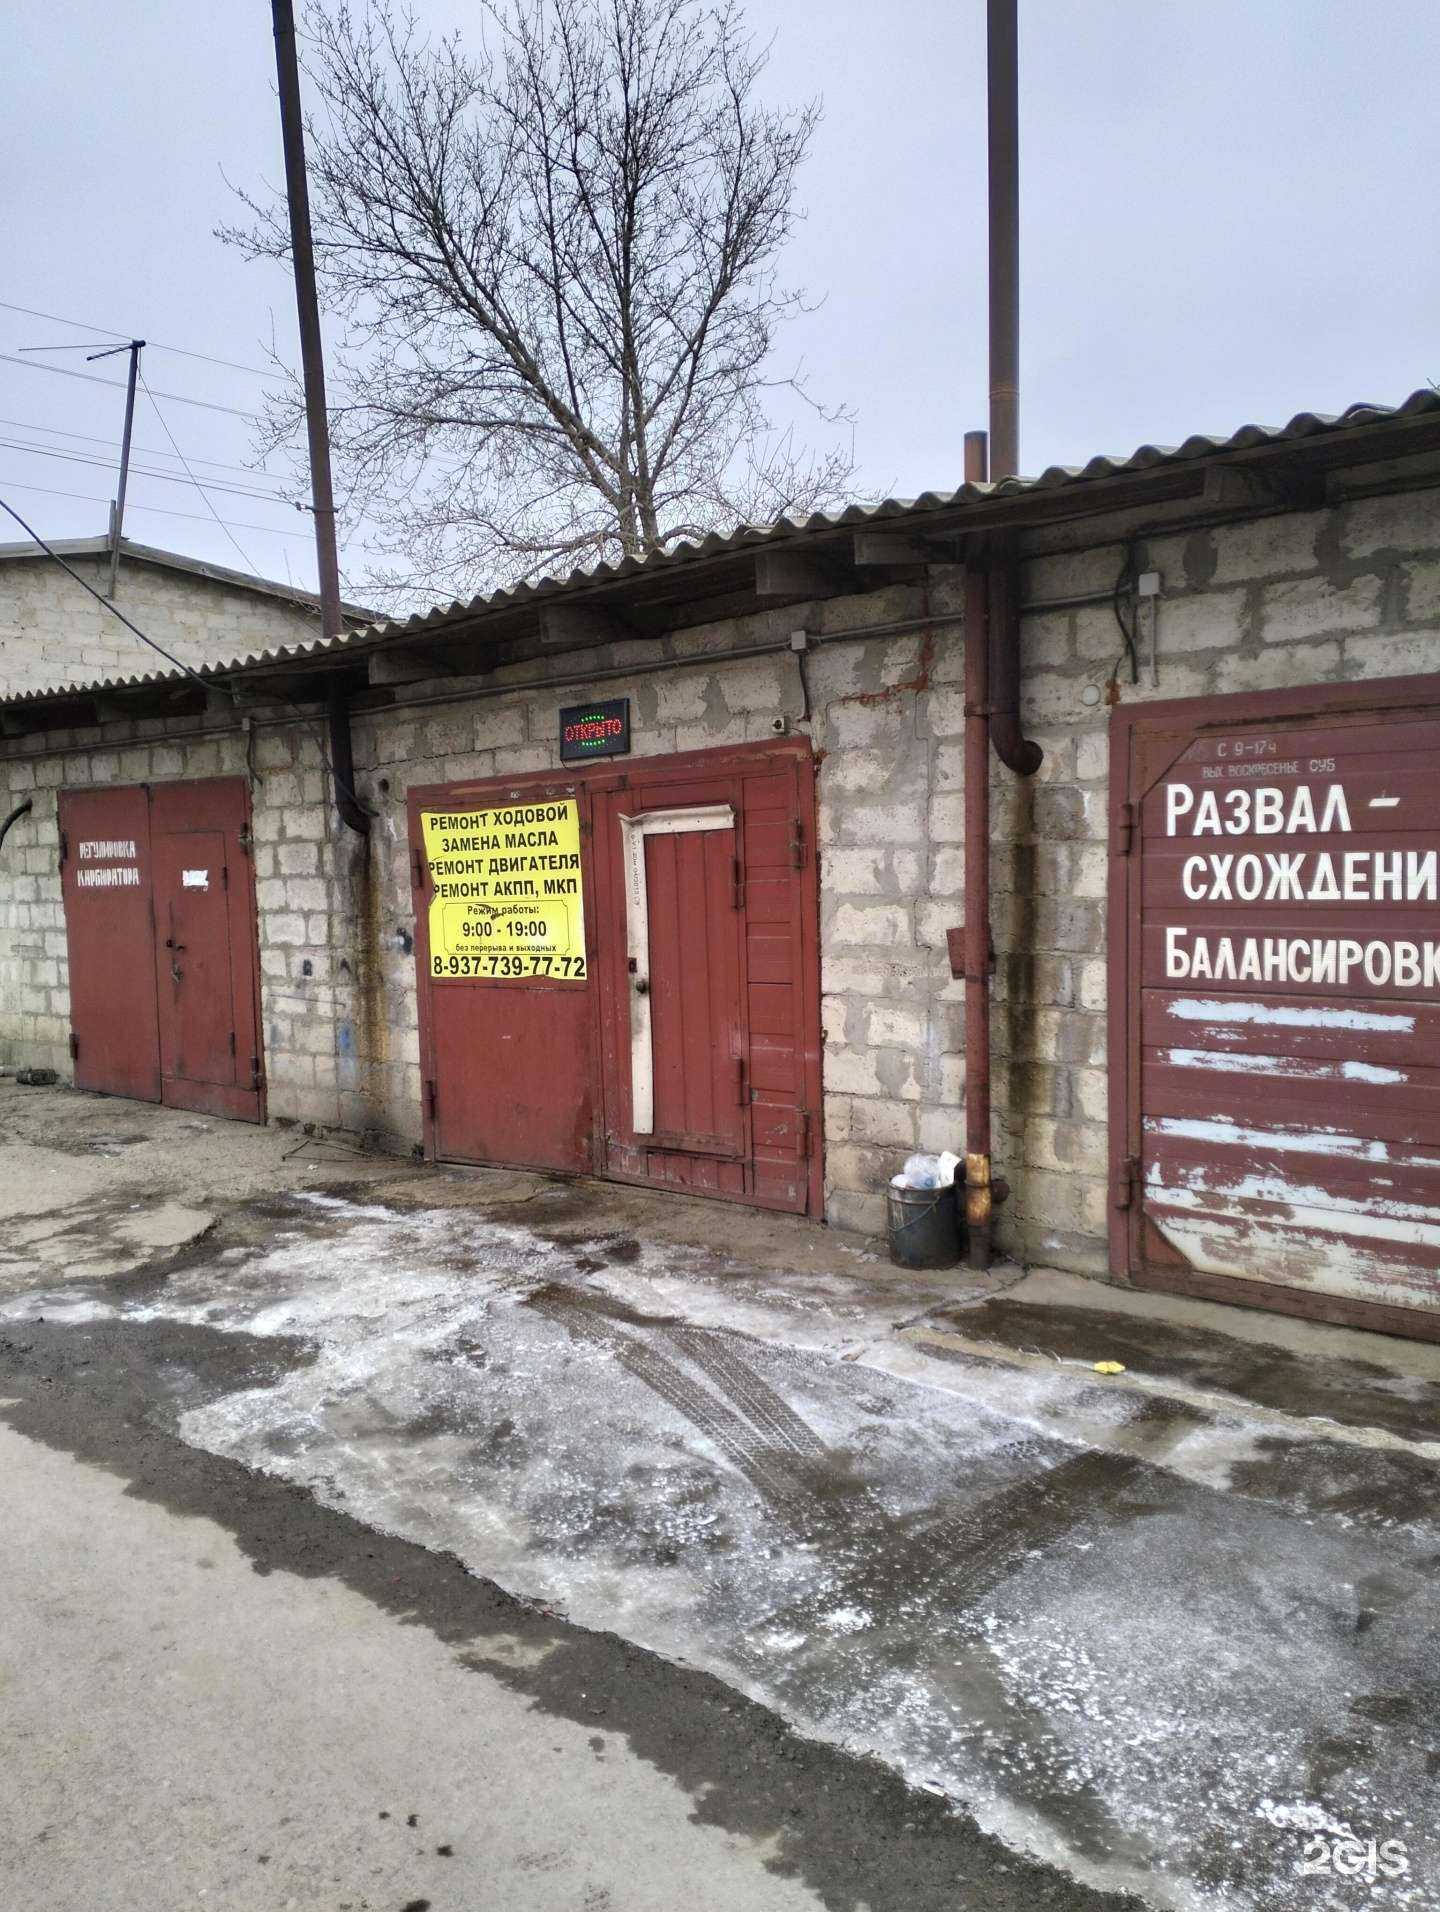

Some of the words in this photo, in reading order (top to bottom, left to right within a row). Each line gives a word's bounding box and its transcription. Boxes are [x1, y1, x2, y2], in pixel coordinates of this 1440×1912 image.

[565, 719, 622, 742] ОТКРЫТО
[430, 813, 488, 831] РЕМОНТ
[493, 802, 568, 827] ХОДОВОЙ
[1166, 783, 1352, 837] РАЗВАЛ
[442, 835, 500, 852] ЗАМЕНА
[505, 831, 559, 849] МАСЛА
[428, 859, 483, 876] РЕМОНТ
[488, 853, 580, 875] ДВИГАТЕЛЯ
[1182, 851, 1437, 900] СХОЖДЕНИ
[494, 880, 539, 898] АКПП,
[544, 878, 577, 895] МКП
[467, 905, 499, 915] Режим
[502, 905, 540, 916] работы:
[462, 921, 492, 937] 9:00
[506, 920, 547, 937] 19:00
[470, 945, 507, 954] перерыва
[516, 945, 557, 953] выходных
[433, 956, 586, 977] 8-937-739-77-72
